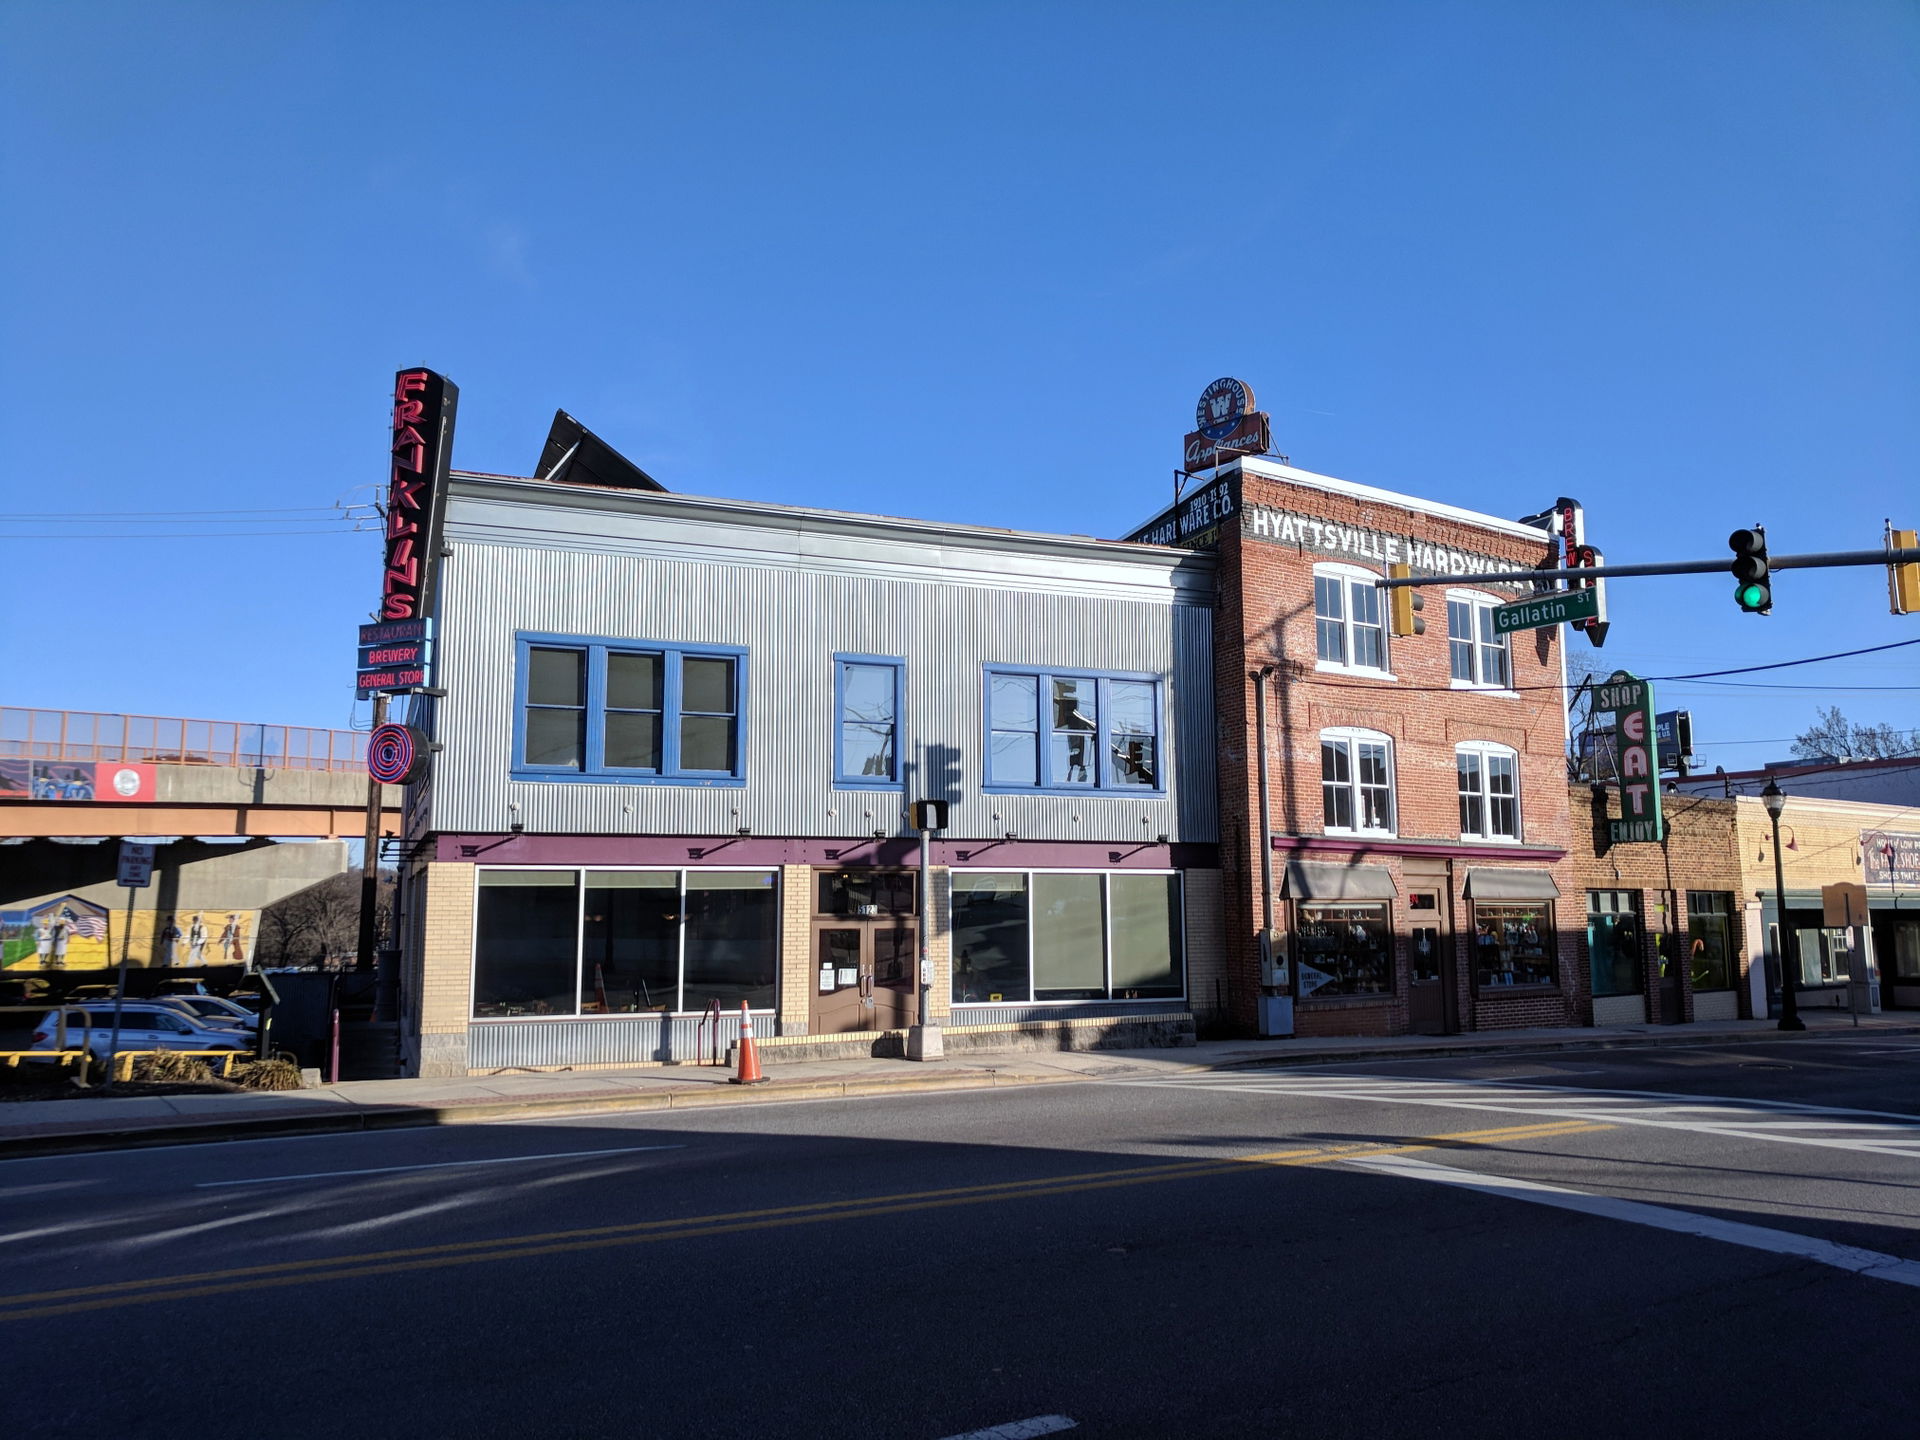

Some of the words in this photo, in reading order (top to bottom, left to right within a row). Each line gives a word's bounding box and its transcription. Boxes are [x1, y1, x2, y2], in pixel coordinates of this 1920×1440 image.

[1185, 431, 1259, 464] Appliances
[382, 372, 428, 620] FRANKLINS
[1253, 509, 1401, 563] HYATTSVILLE
[1563, 507, 1577, 567] BREW
[1498, 602, 1566, 628] Gallatin
[1577, 592, 1591, 604] ST
[369, 648, 418, 664] BREWERY
[360, 673, 395, 687] GENERAL
[1600, 684, 1643, 709] SHOP
[1623, 710, 1648, 815] EAT
[1610, 820, 1654, 842] ENJOY
